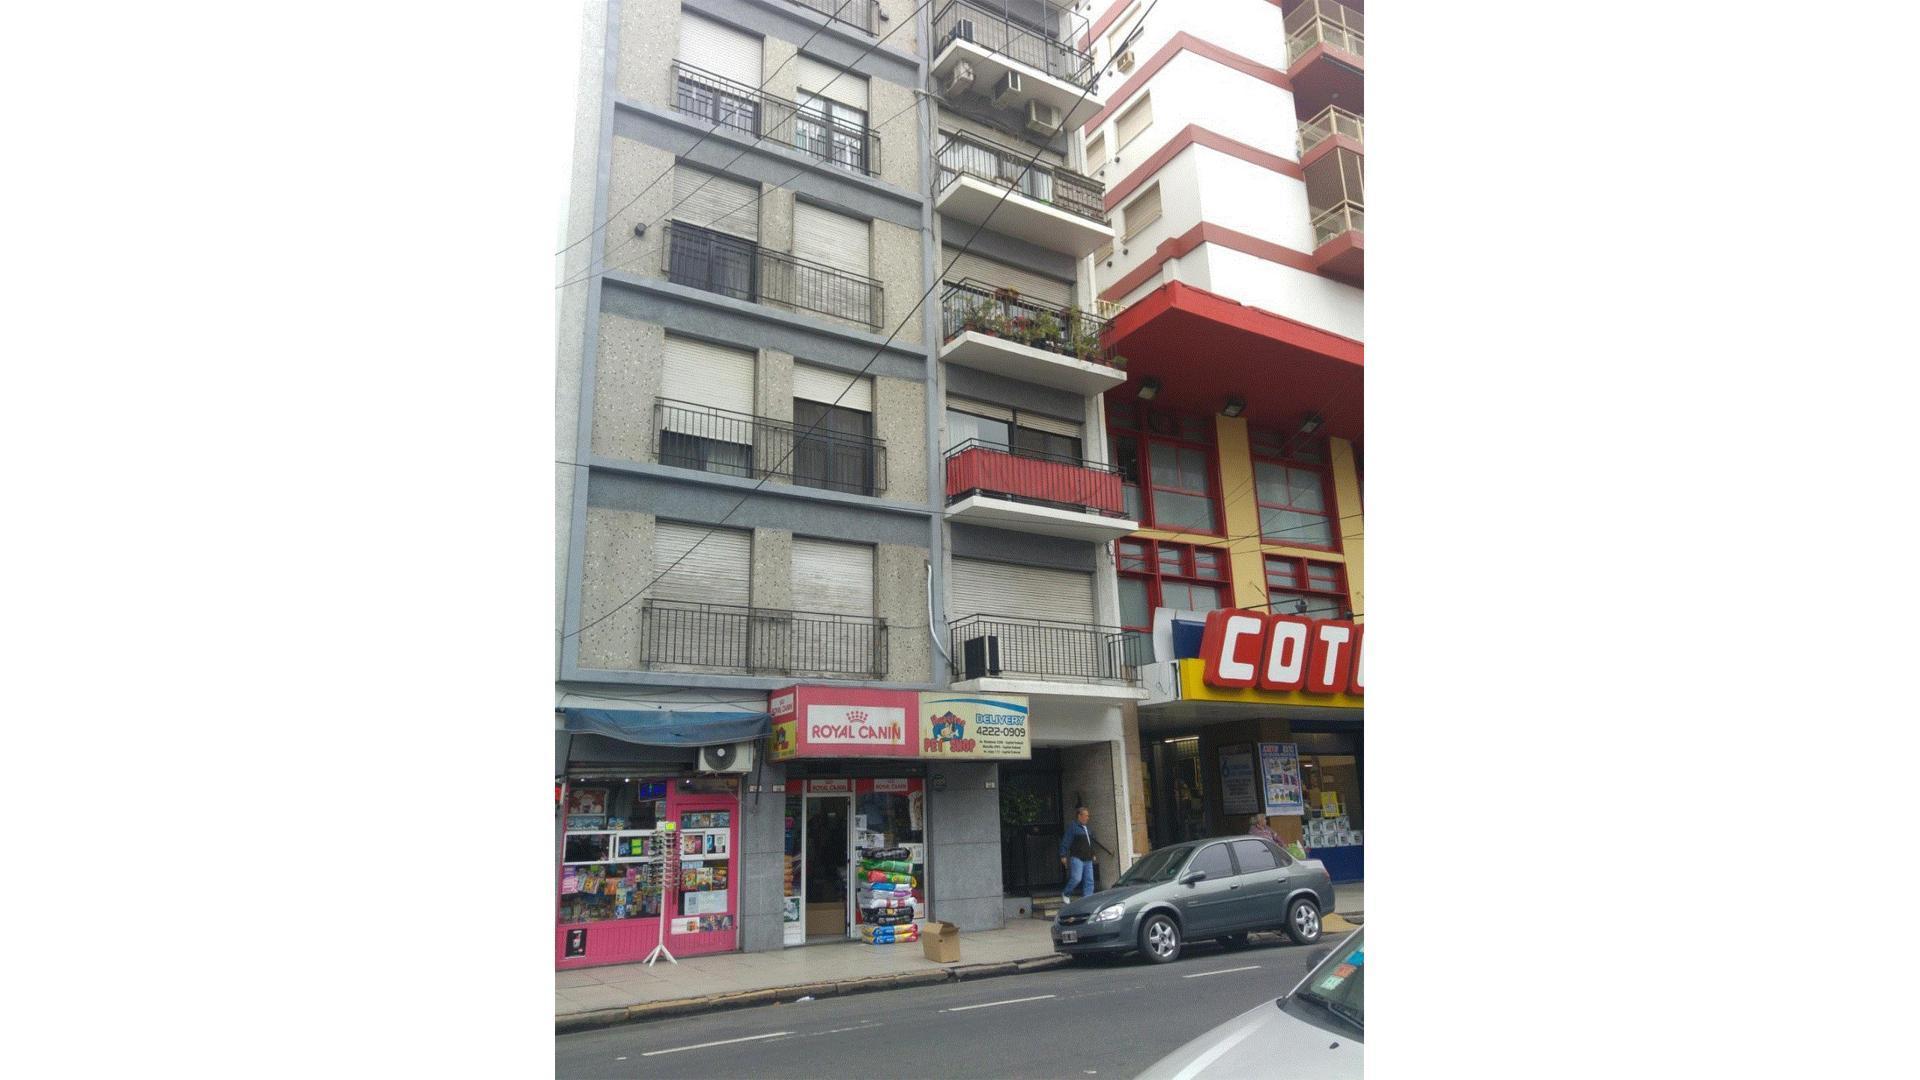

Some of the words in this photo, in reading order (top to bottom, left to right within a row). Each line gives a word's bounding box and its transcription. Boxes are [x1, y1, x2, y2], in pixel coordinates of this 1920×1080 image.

[1219, 615, 1364, 687] COT
[976, 713, 1025, 726] DELIVERY
[812, 724, 855, 739] ROYAL
[858, 725, 901, 740] CANIN
[976, 726, 1026, 737] 4222-0909
[924, 737, 943, 752] PET
[950, 738, 976, 752] SHOP
